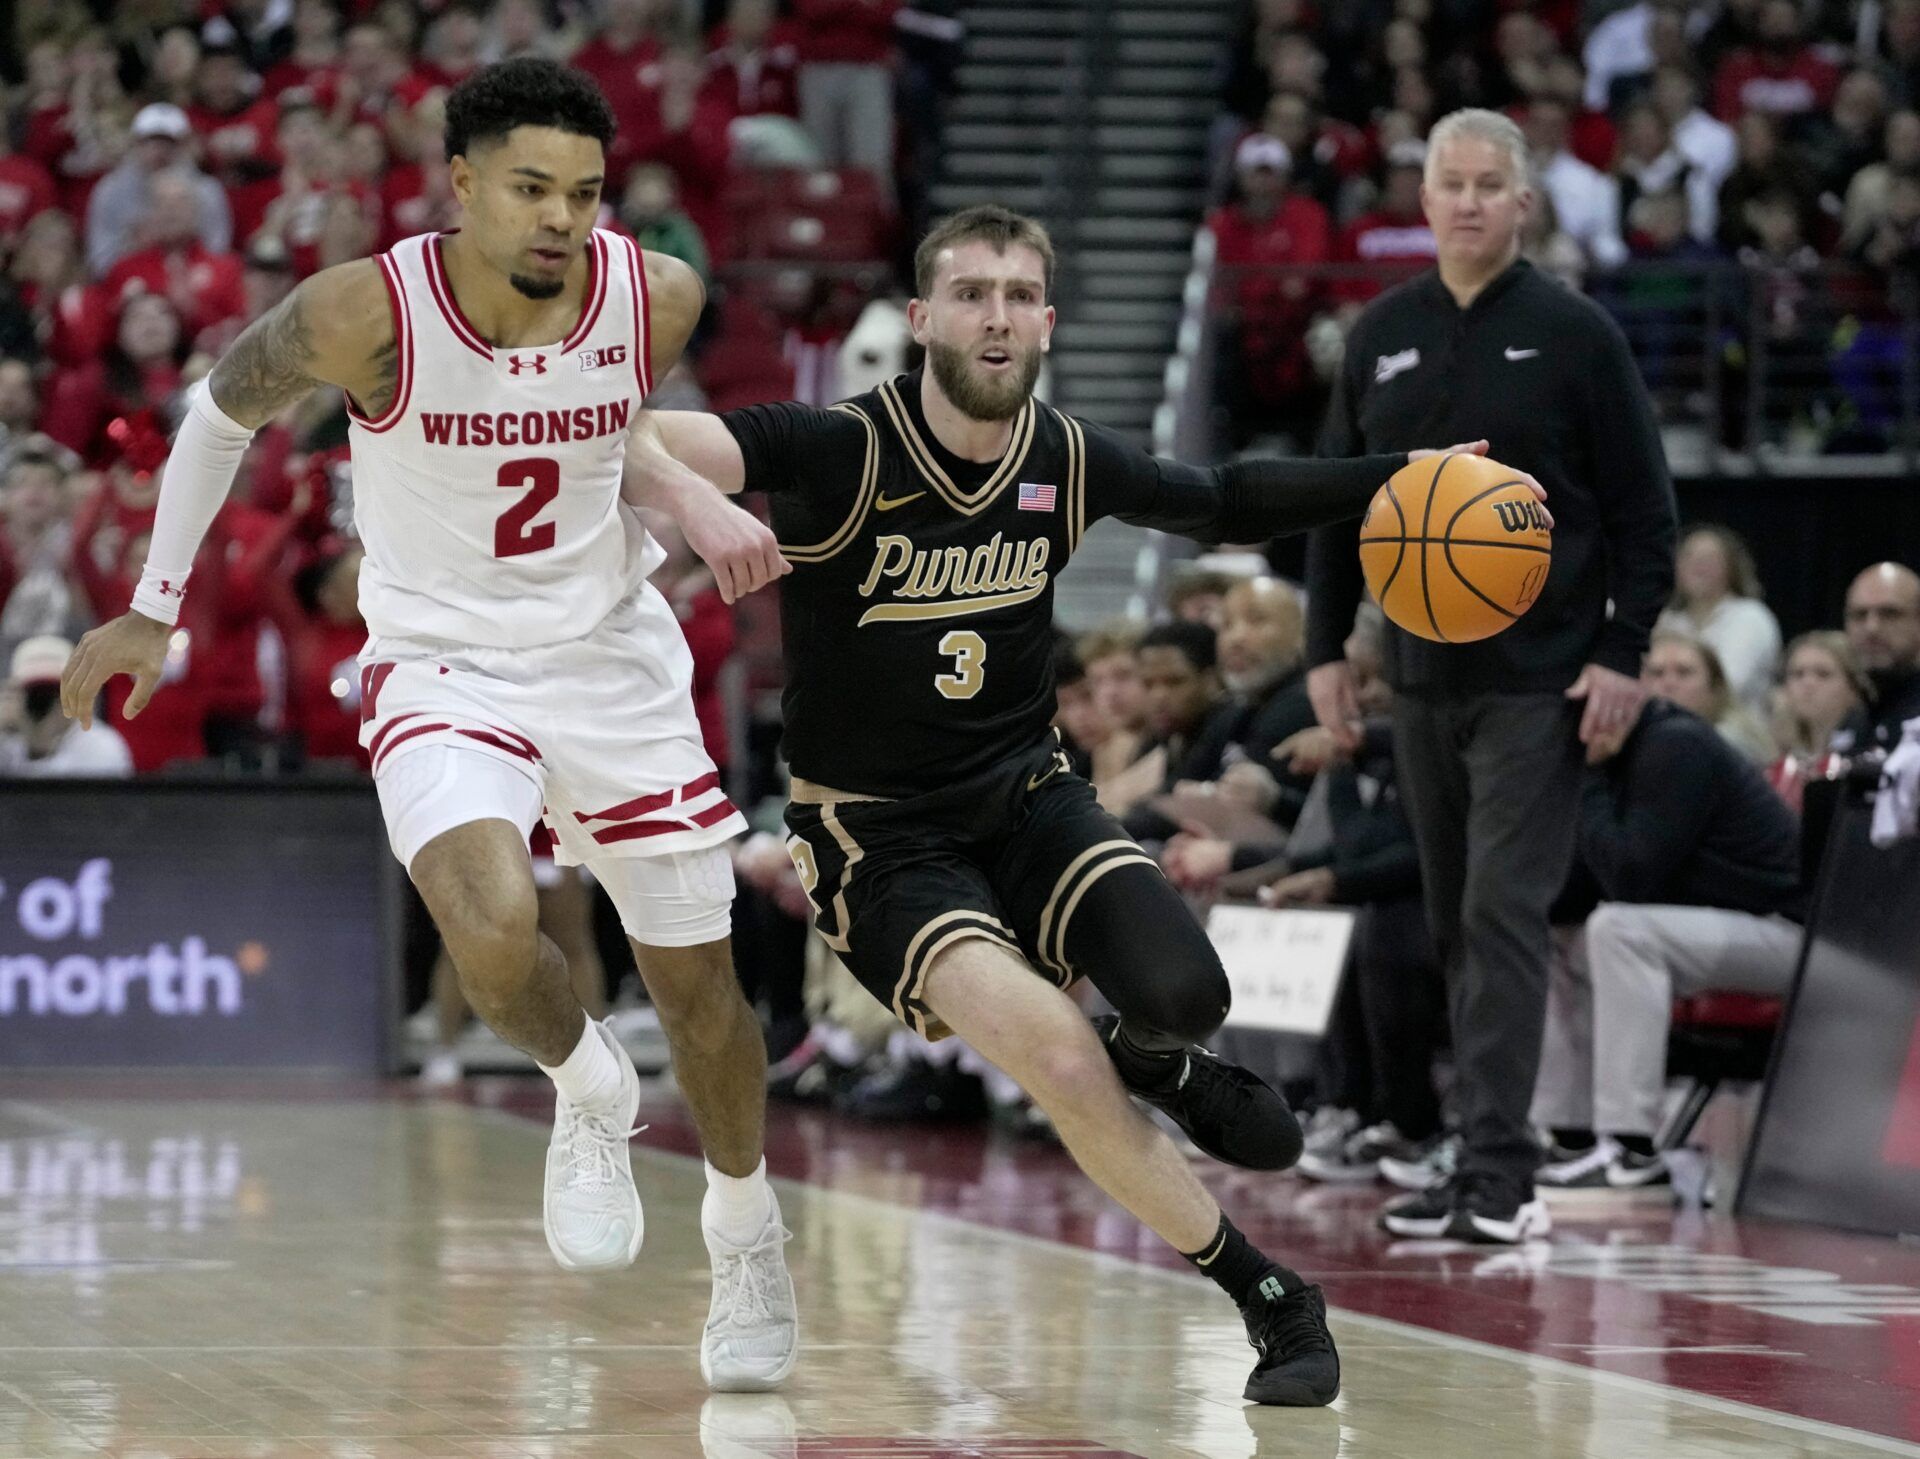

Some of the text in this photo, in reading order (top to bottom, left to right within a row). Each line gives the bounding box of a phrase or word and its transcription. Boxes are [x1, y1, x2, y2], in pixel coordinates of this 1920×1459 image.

[420, 398, 630, 446] WISCONSIN
[494, 457, 560, 558] 2
[858, 531, 1050, 602] Purdue
[934, 630, 987, 699] 3
[18, 858, 112, 940] of
[0, 936, 242, 1016] north
